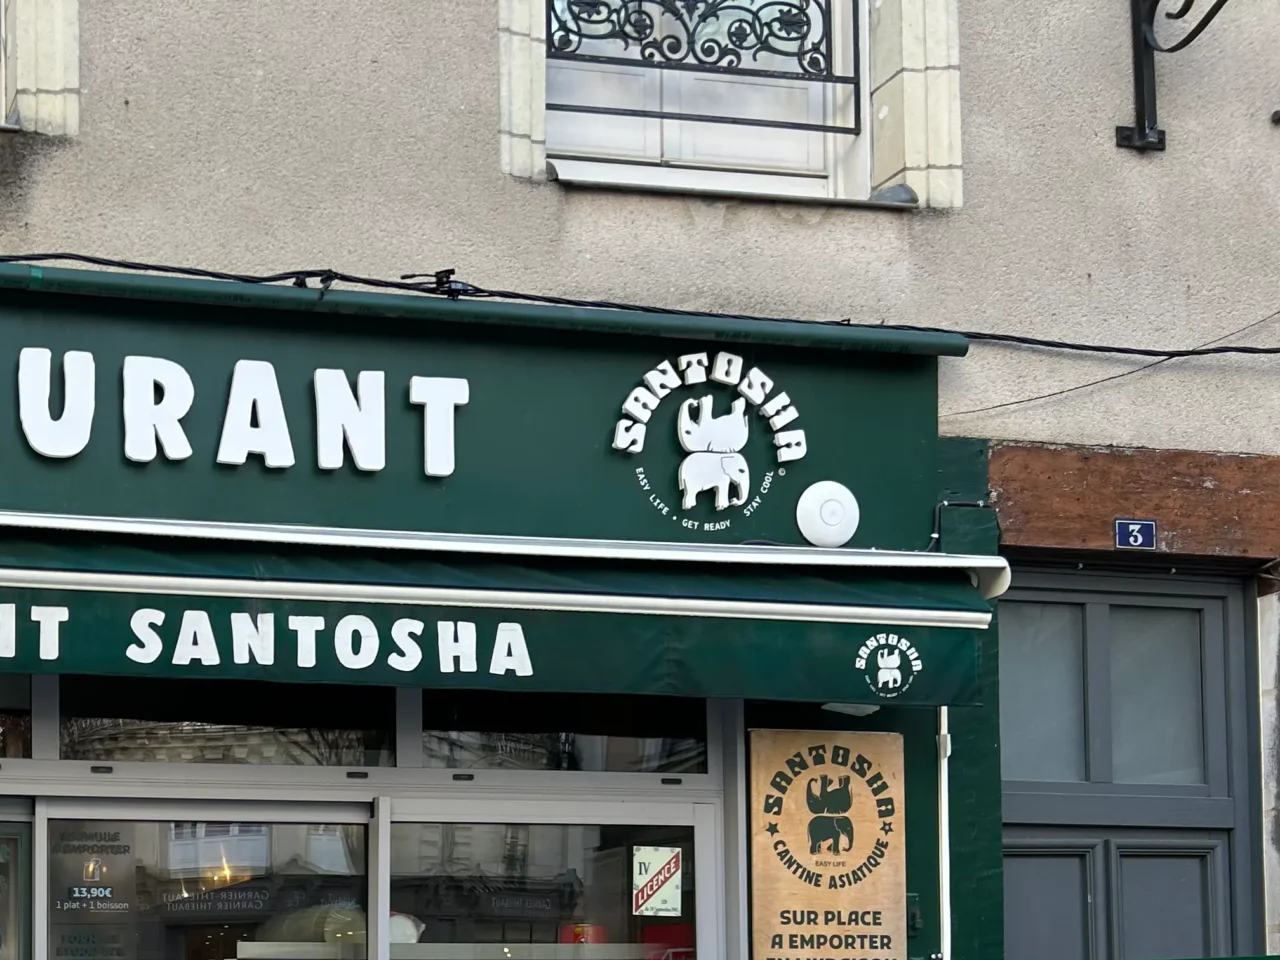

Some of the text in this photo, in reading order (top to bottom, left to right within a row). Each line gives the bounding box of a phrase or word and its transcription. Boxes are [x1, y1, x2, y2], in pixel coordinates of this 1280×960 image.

[612, 351, 807, 462] SANTOSHA
[1128, 524, 1143, 546] 3
[125, 608, 534, 677] SANTOSHA
[855, 633, 923, 671] SANTOSHA
[763, 744, 896, 819] SANTOSHA
[638, 862, 651, 875] IV
[773, 837, 890, 890] CANTINE ASIATIQUE
[833, 860, 846, 868] LIFE
[638, 857, 677, 906] LICENCE
[72, 887, 112, 899] 13,90€
[64, 901, 129, 910] plat boisson
[780, 910, 882, 926] SUR PLACE
[788, 934, 892, 950] EMPORTER
